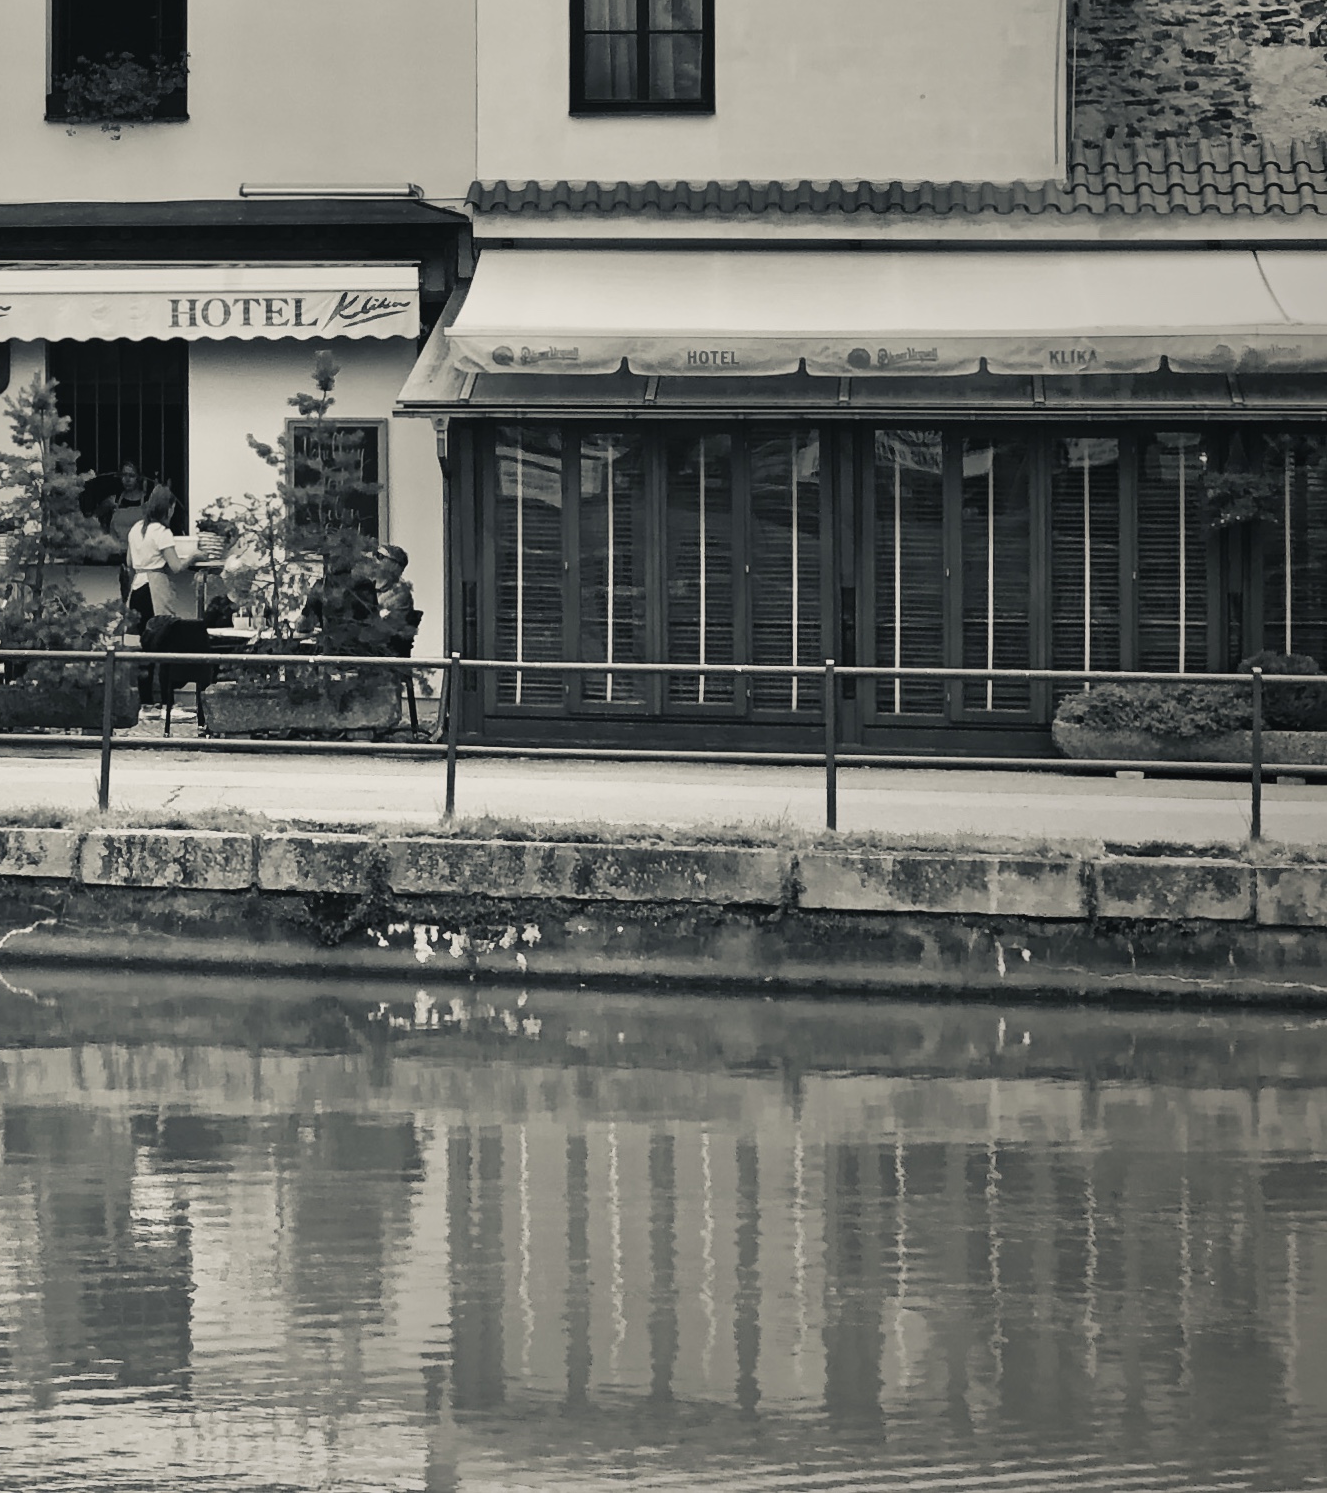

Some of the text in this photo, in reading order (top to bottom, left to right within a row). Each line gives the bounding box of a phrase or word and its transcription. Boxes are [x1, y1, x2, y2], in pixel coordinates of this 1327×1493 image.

[168, 298, 319, 328] HOTEL
[687, 350, 740, 365] HOTEL
[1048, 349, 1098, 364] KLIKA
